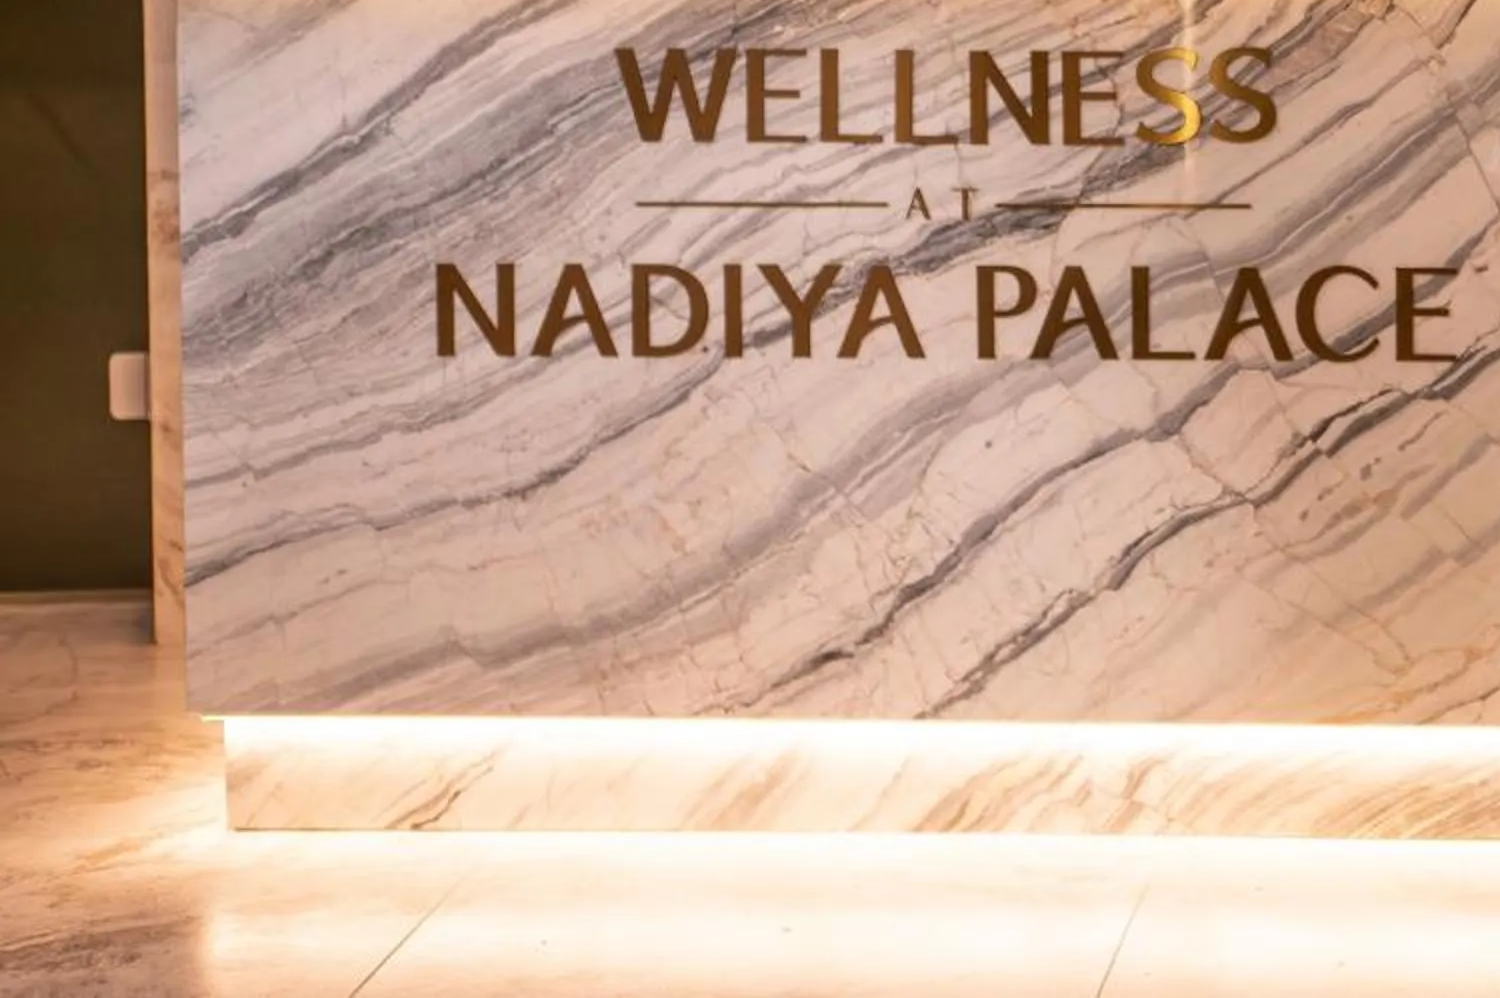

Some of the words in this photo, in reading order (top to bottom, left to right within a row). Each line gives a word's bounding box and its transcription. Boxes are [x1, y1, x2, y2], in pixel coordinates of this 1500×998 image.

[614, 47, 1277, 146] WELLNESS
[905, 186, 979, 221] AT
[436, 263, 926, 358] NADIYA
[976, 264, 1458, 363] PALACE
